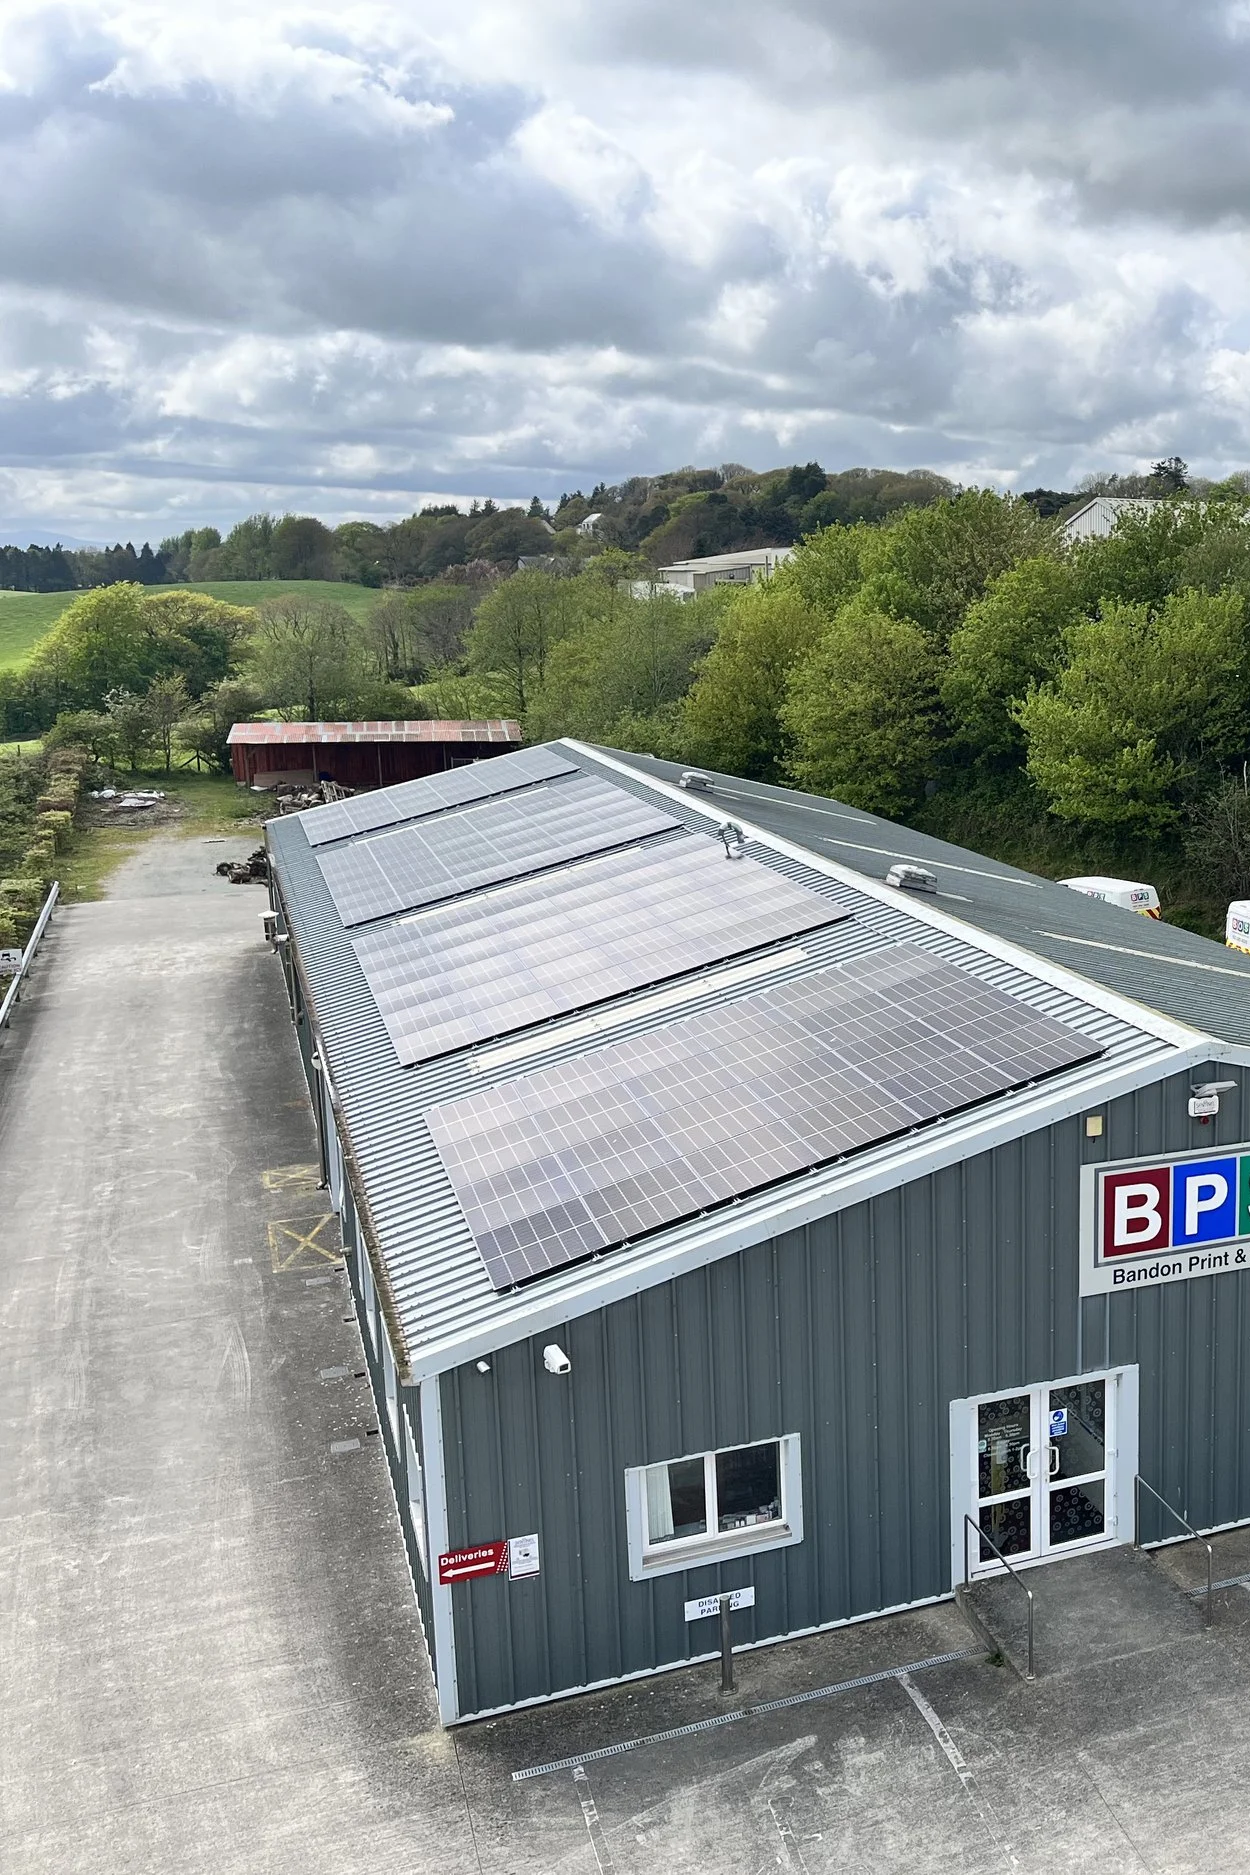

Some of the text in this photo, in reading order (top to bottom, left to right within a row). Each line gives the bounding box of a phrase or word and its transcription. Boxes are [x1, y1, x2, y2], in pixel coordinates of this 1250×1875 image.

[1113, 1262, 1182, 1285] Bandon
[1189, 1252, 1229, 1272] Print
[1235, 1248, 1246, 1264] &
[440, 1549, 494, 1567] Deliveries
[698, 1592, 741, 1607] DISAED
[700, 1601, 740, 1615] PARG
